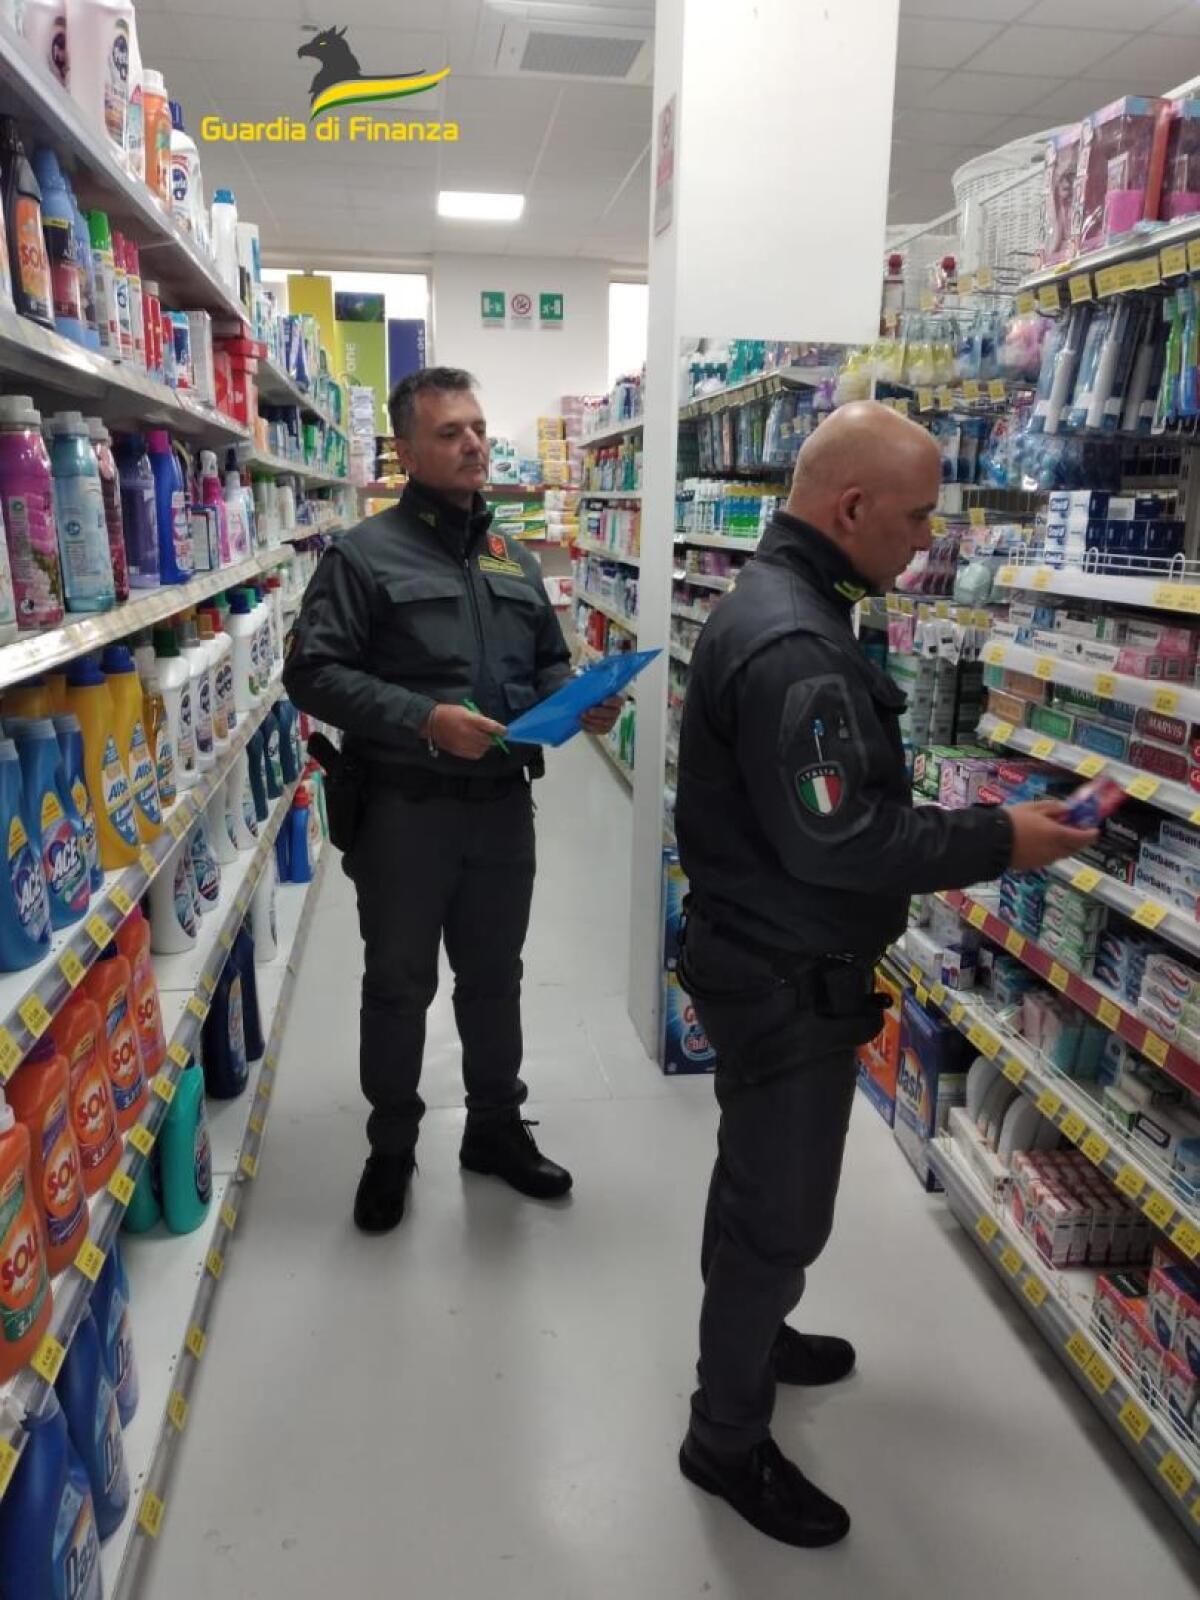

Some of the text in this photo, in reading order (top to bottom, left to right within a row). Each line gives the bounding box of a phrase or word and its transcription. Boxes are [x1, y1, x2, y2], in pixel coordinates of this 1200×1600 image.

[800, 767, 836, 783] ITALIA
[54, 835, 80, 884] ACE
[19, 863, 42, 917] ACE
